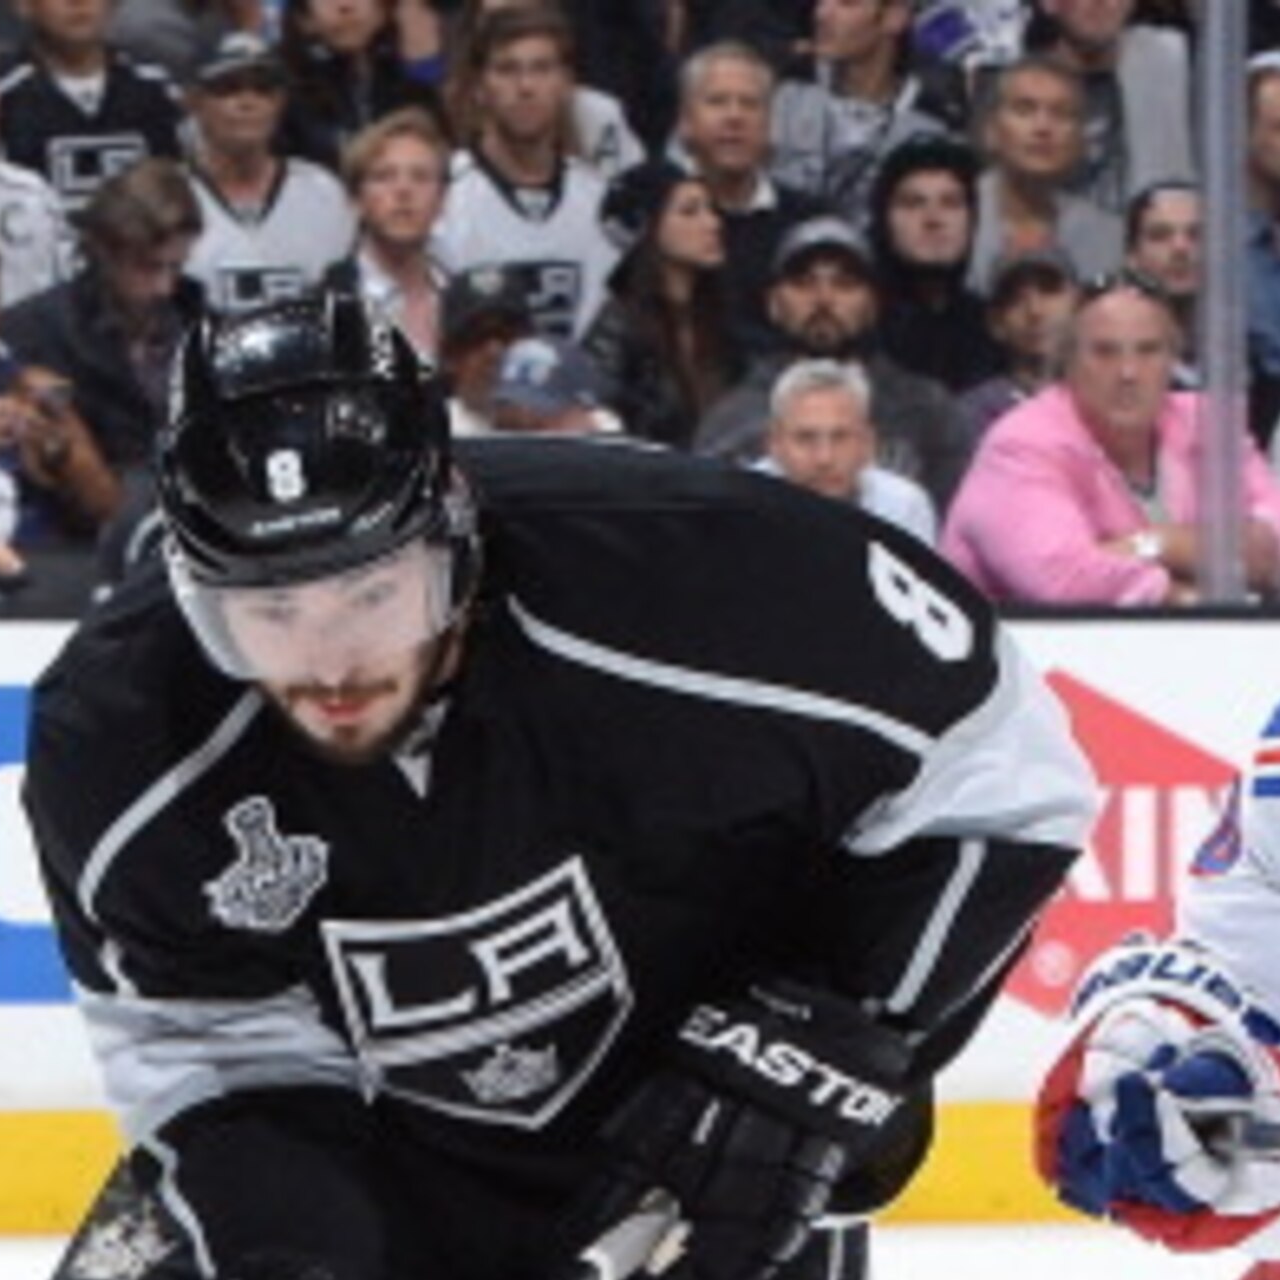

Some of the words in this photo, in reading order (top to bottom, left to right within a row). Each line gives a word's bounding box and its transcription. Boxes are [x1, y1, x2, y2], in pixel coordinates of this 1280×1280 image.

[267, 449, 304, 502] 8
[866, 541, 976, 662] 8
[350, 897, 588, 1030] LA
